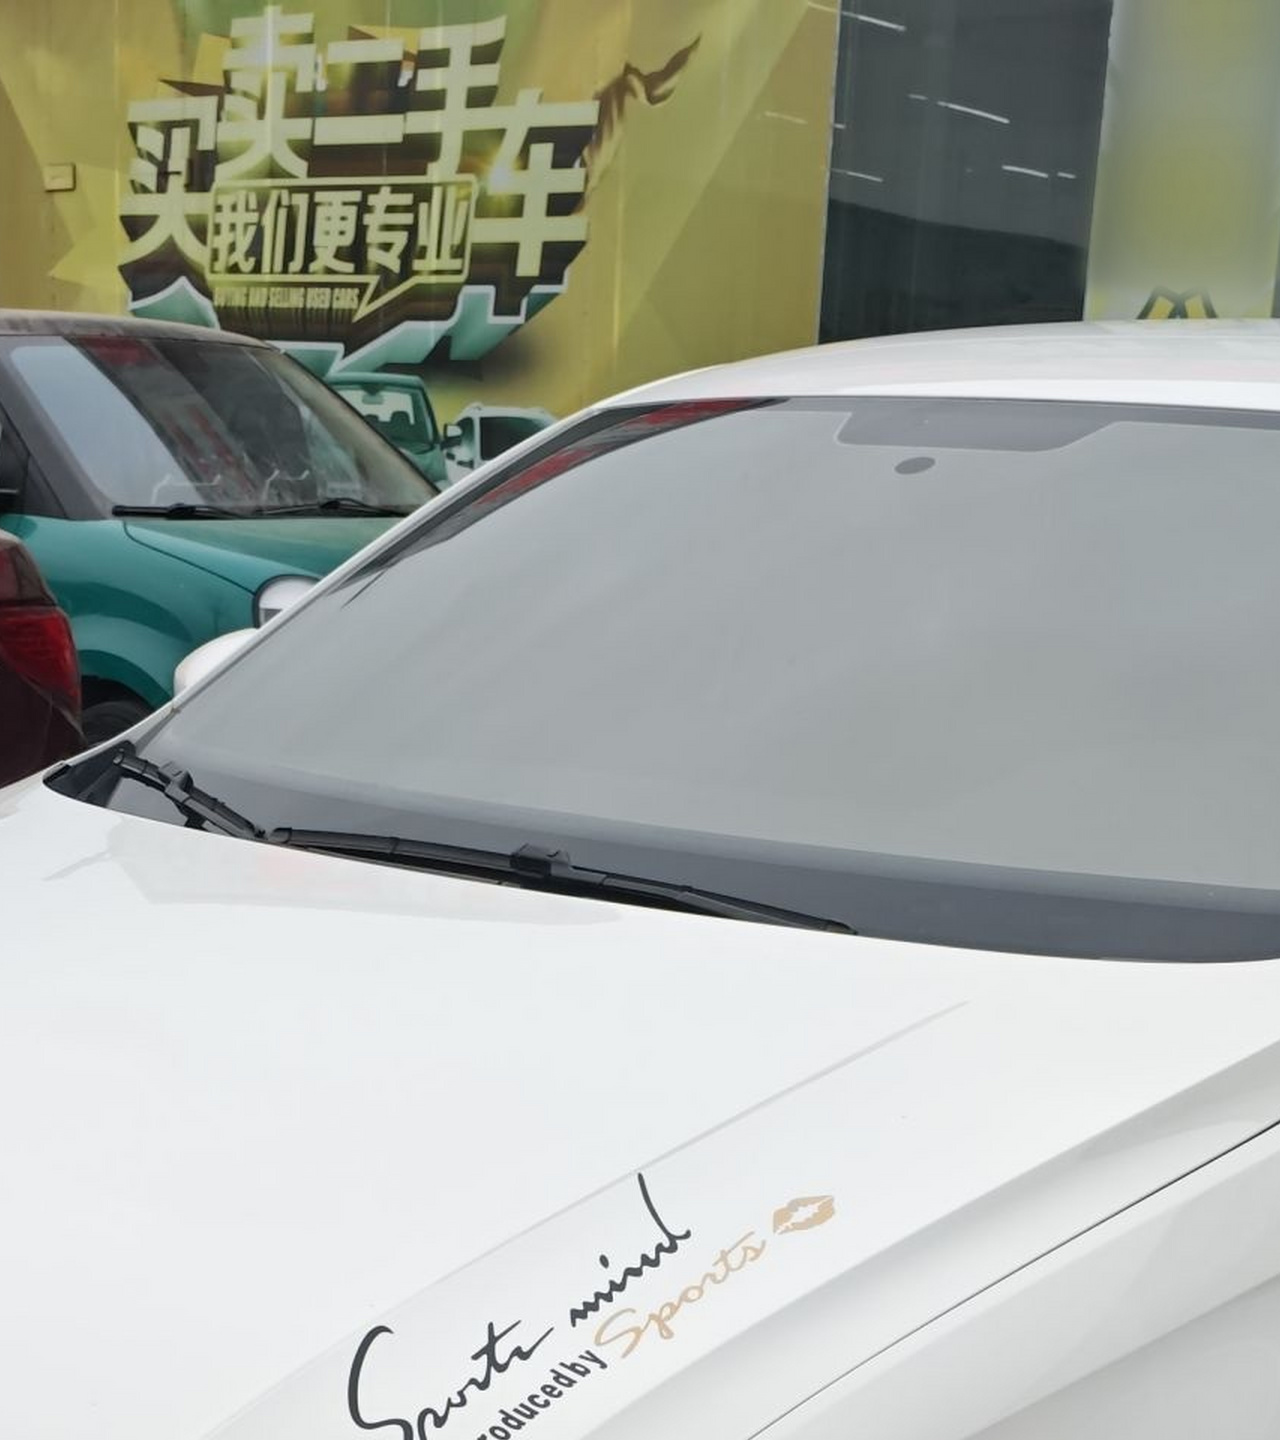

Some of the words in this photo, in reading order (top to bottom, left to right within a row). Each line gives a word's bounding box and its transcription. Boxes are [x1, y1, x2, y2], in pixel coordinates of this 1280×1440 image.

[119, 5, 600, 279] 买卖二手车
[213, 187, 466, 274] 我们更专业
[268, 287, 305, 309] SELLING
[306, 287, 332, 309] USED
[333, 287, 360, 310] CARS
[570, 1172, 692, 1328] mind
[593, 1230, 767, 1360] Sports
